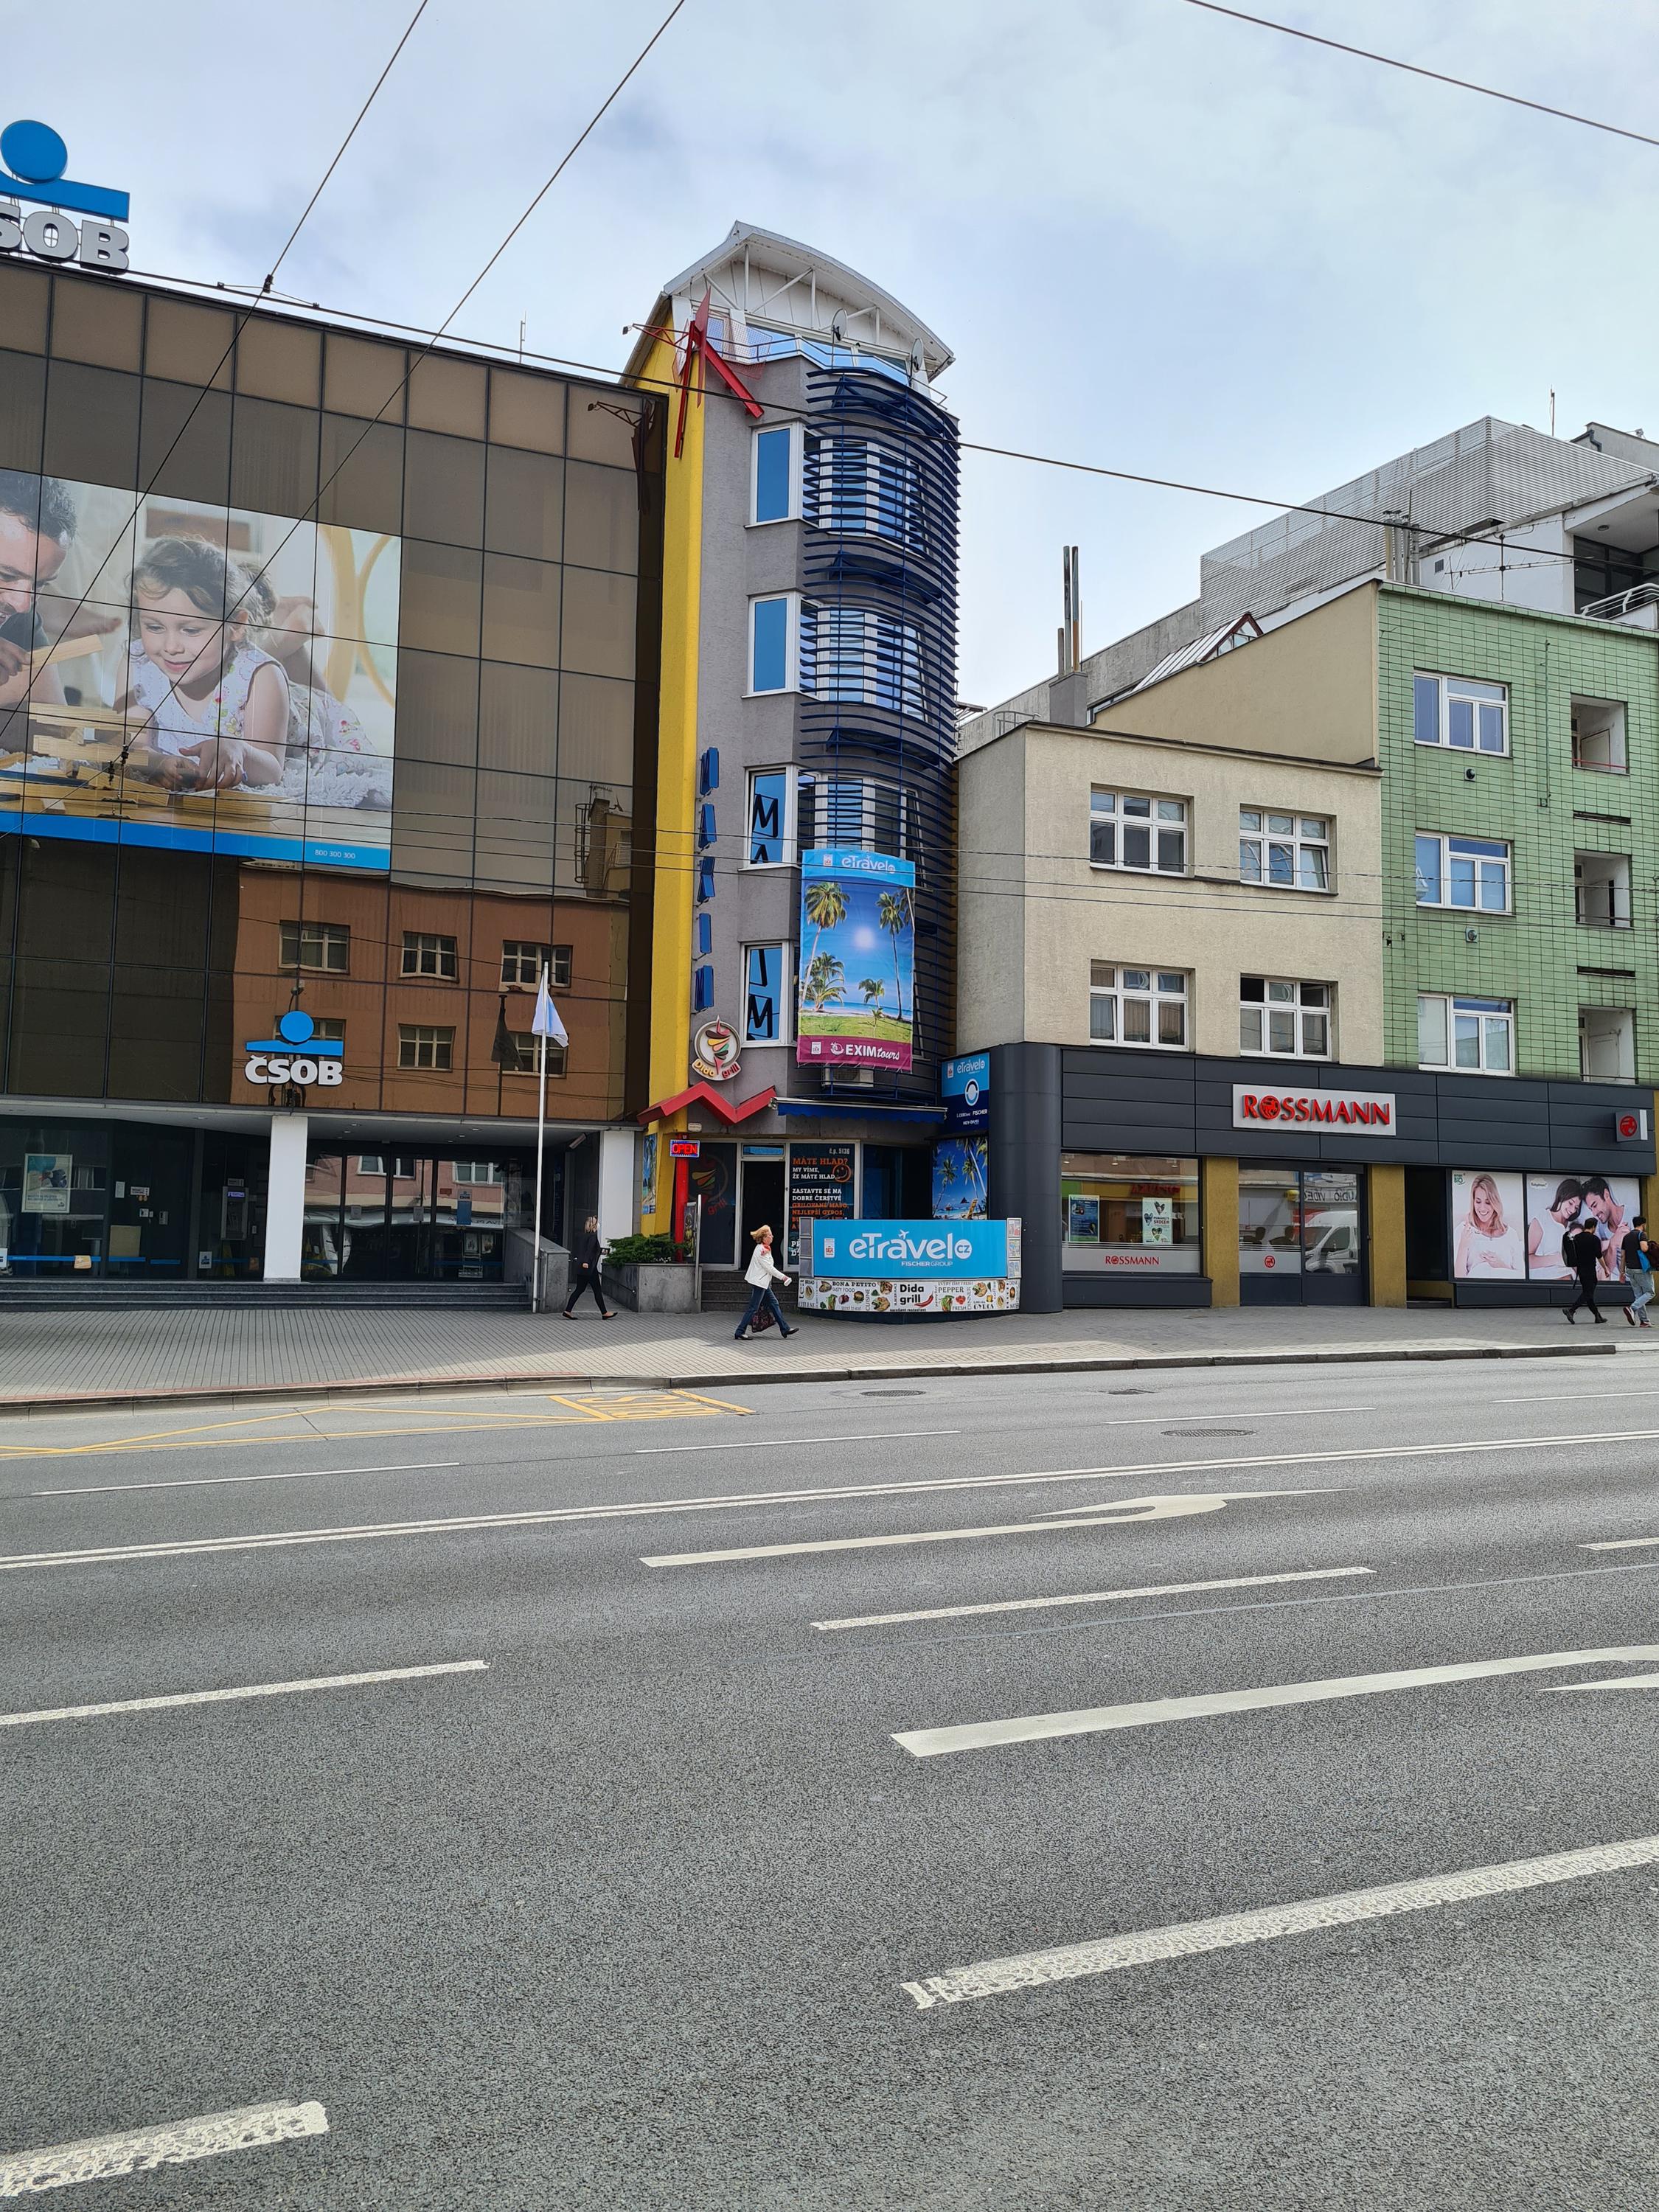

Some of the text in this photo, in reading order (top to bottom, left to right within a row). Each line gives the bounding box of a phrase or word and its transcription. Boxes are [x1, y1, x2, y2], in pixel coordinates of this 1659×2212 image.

[344, 851, 355, 859] 300
[245, 1055, 343, 1086] ČSOB
[1242, 1094, 1390, 1125] ROSSMANN
[672, 1144, 698, 1154] OPEN
[793, 1156, 817, 1165] MÁTE
[1105, 1256, 1160, 1265] ROSSMANN
[900, 1284, 924, 1293] Dida
[900, 1294, 920, 1305] grill
